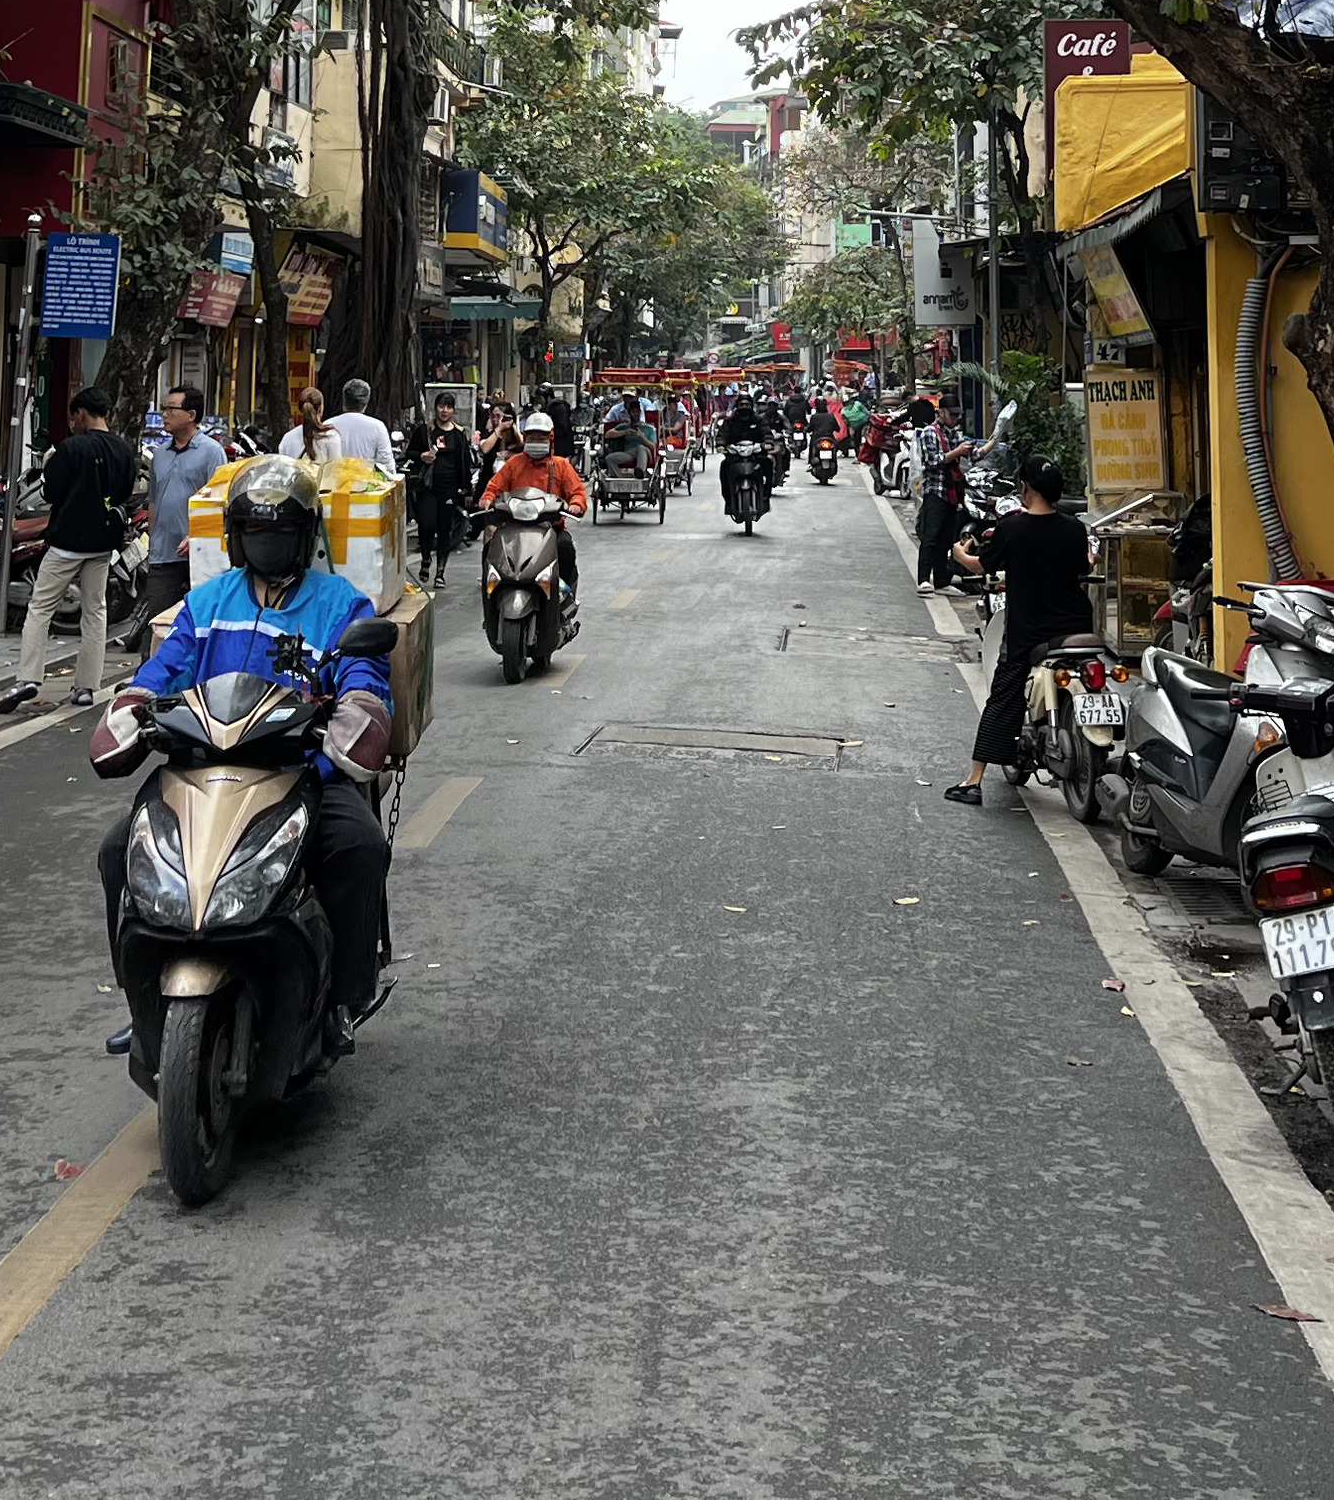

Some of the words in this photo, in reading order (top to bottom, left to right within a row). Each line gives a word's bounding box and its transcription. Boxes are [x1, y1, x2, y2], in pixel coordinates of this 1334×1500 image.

[1057, 31, 1117, 57] Café
[1096, 342, 1121, 361] 47
[1088, 381, 1127, 407] THẠCH
[1130, 380, 1155, 401] ANH
[1081, 695, 1115, 709] 29-AA
[1079, 709, 1121, 724] 677.55
[1272, 910, 1331, 947] 29-P1
